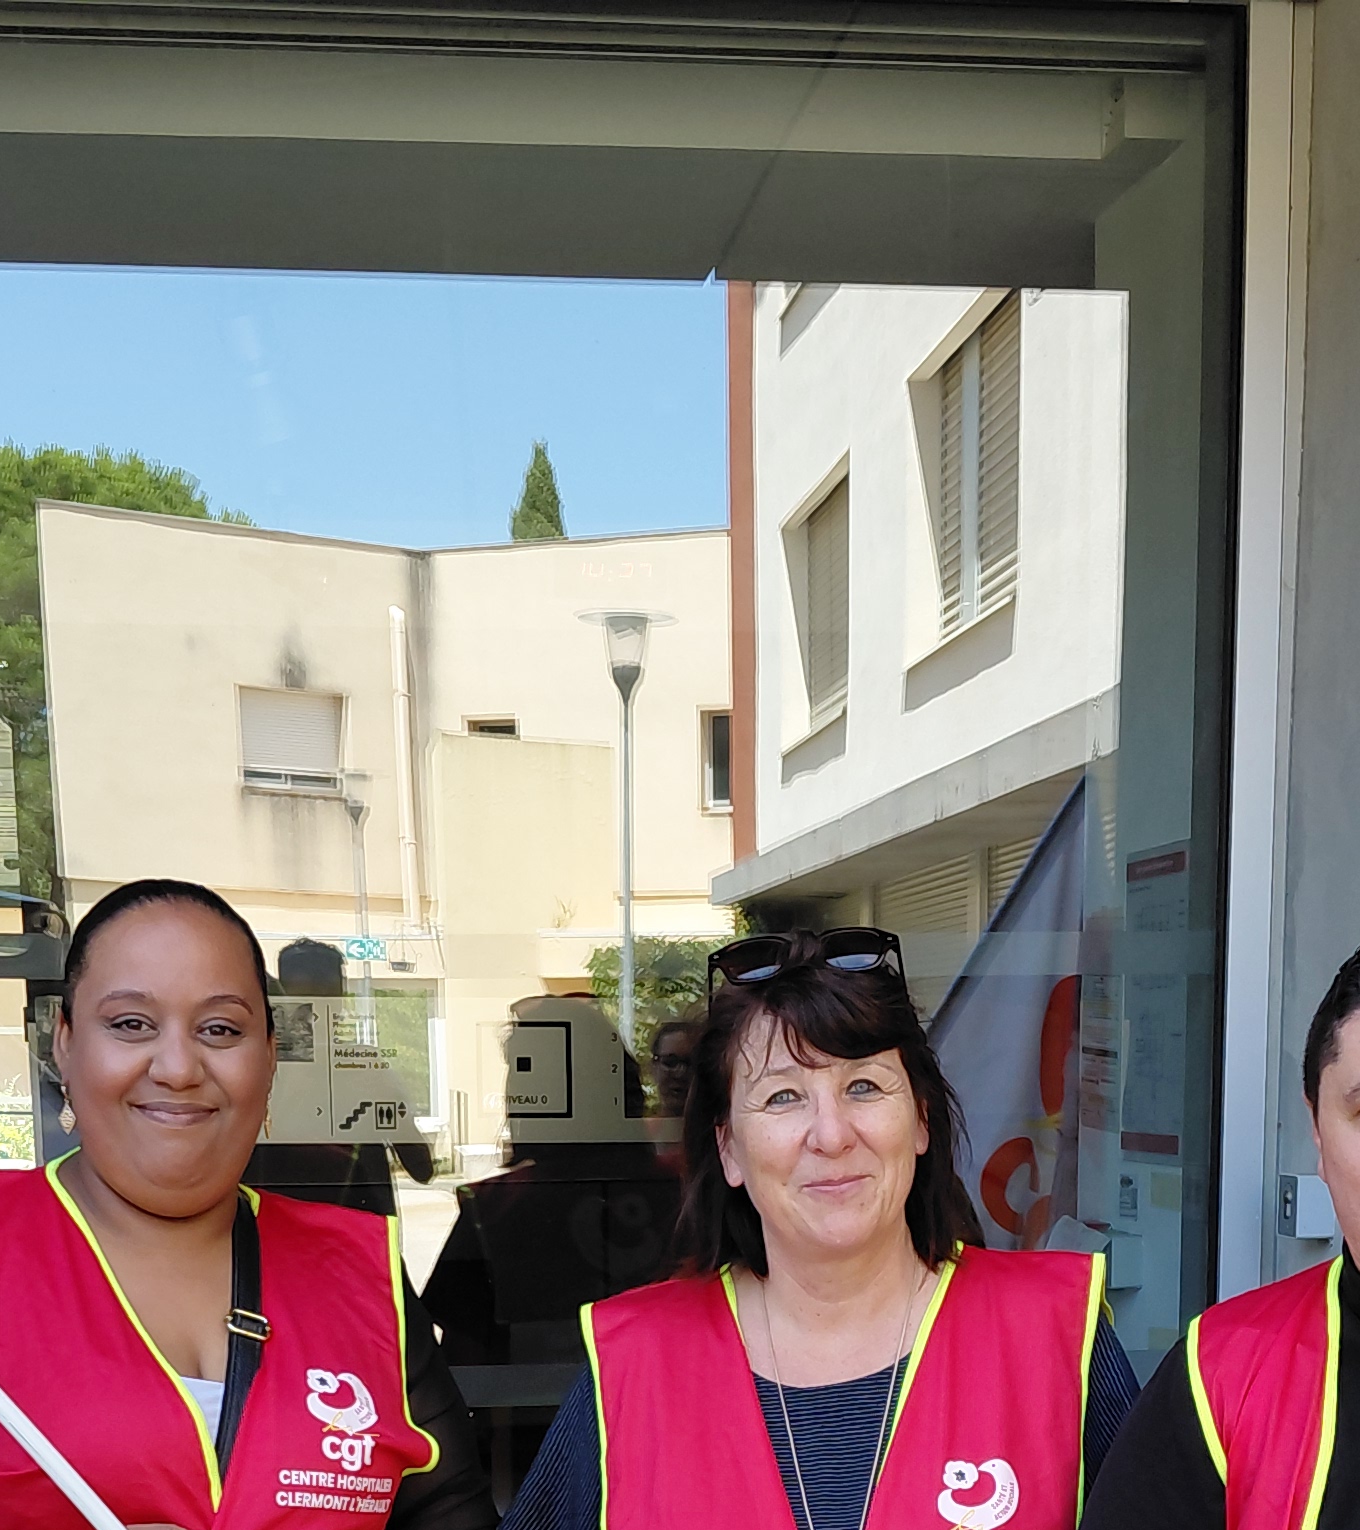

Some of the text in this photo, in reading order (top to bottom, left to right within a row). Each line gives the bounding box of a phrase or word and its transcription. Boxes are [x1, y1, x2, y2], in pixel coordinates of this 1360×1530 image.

[611, 1032, 618, 1042] 3
[334, 1048, 398, 1058] Médecine SSR
[611, 1063, 618, 1073] 2
[321, 1435, 376, 1471] cgt
[279, 1470, 335, 1488] CENTRE
[276, 1491, 350, 1511] CLERMONT
